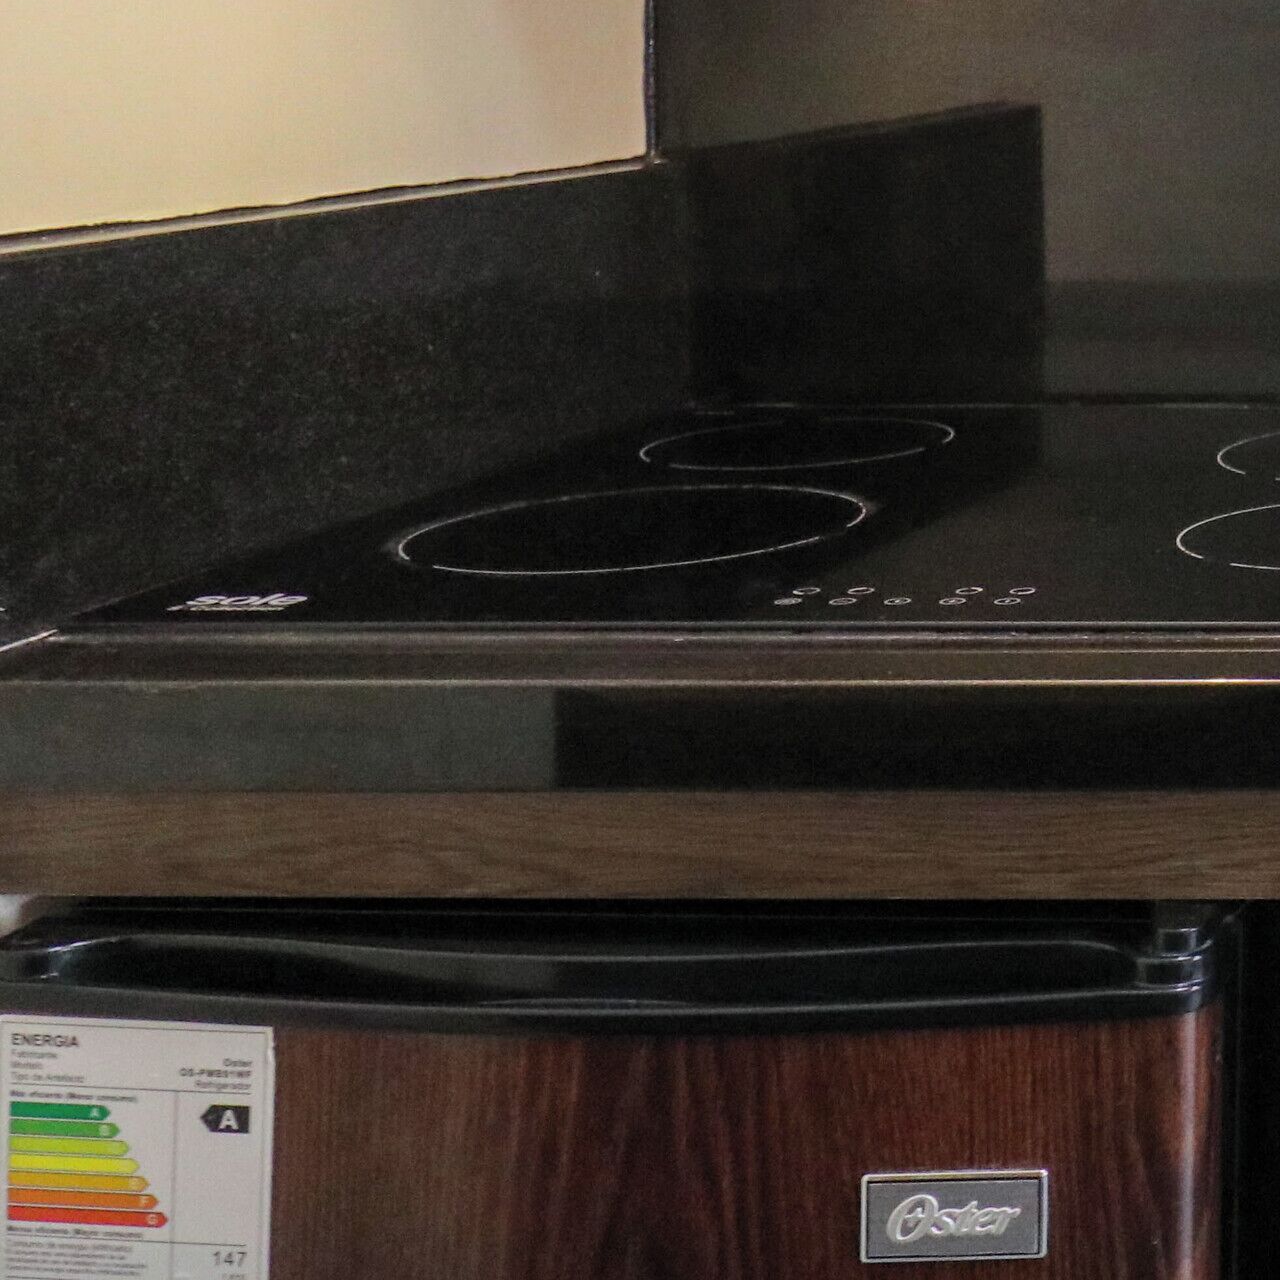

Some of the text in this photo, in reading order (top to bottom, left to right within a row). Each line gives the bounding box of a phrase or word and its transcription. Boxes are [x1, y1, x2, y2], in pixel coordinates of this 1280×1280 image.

[11, 1033, 79, 1048] ENERGIA
[218, 1109, 240, 1130] A
[886, 1193, 1022, 1244] Oster
[213, 1251, 247, 1266] 147
